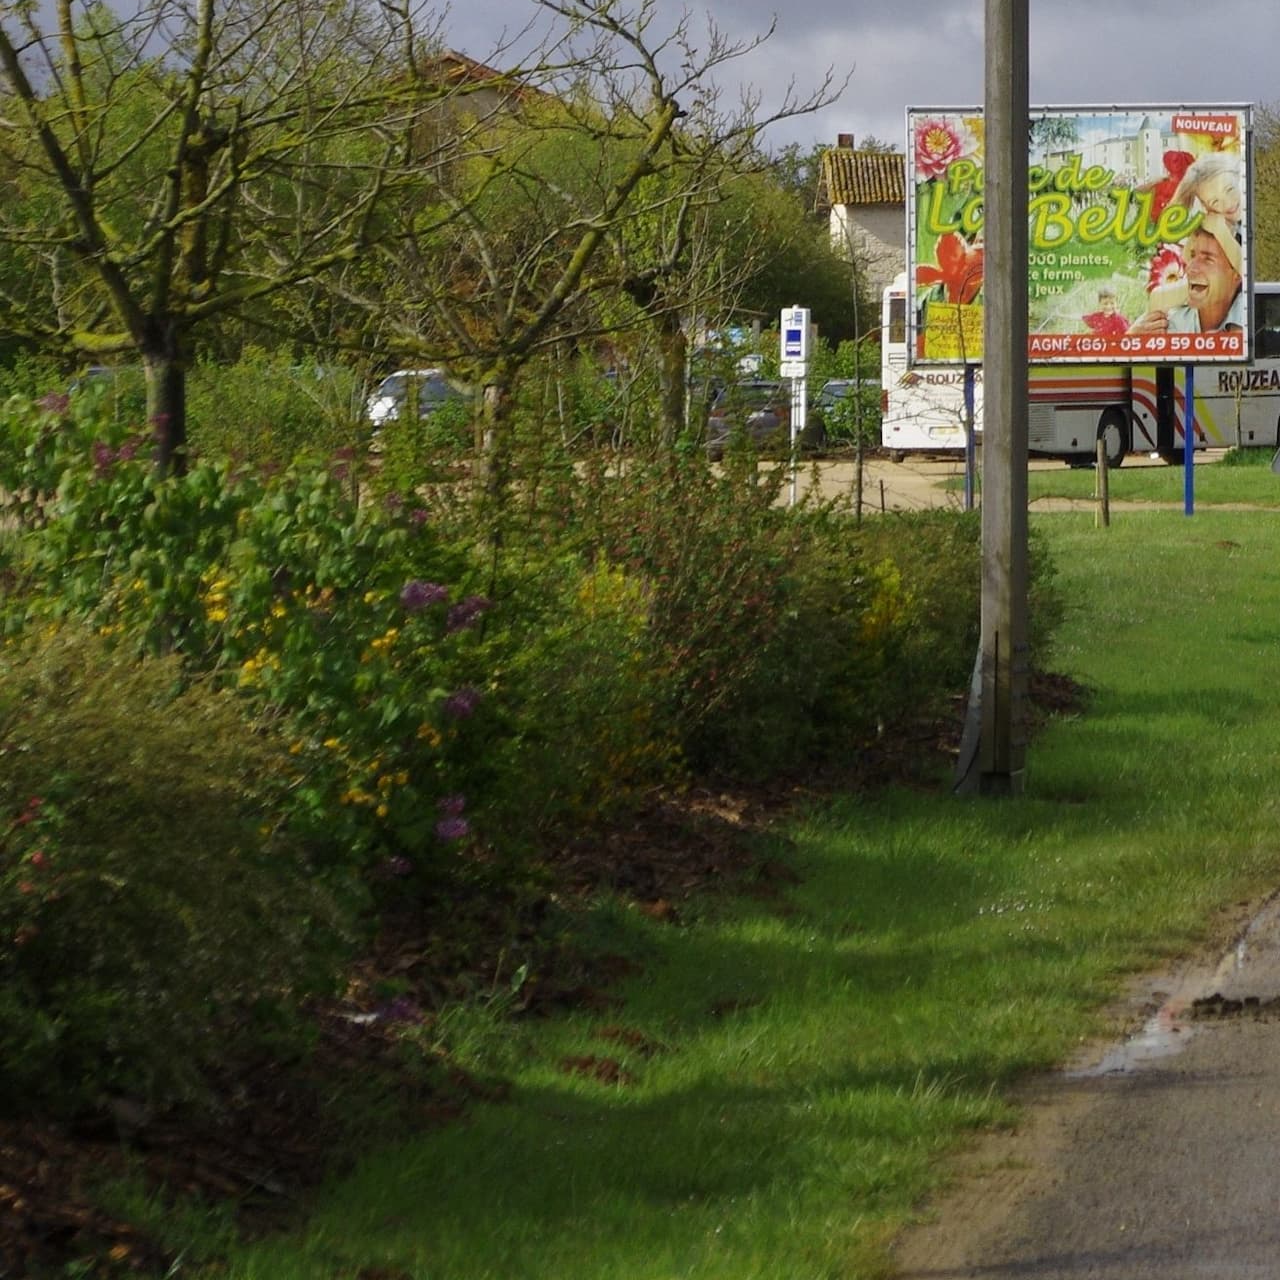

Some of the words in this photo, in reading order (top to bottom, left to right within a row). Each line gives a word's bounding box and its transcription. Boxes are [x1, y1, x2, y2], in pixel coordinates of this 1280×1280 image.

[1176, 118, 1232, 132] NOUVEAU
[1055, 154, 1114, 190] de
[1028, 186, 1204, 248] Belle
[1060, 253, 1113, 267] plantes,
[1043, 268, 1085, 281] ferme,
[1035, 282, 1064, 297] jeux
[1028, 335, 1072, 351] AGNÉ
[1076, 338, 1107, 352] (86)
[1120, 337, 1141, 351] 05
[1145, 337, 1166, 351] 49
[1170, 336, 1190, 350] 59
[1194, 336, 1216, 350] 06
[1220, 336, 1240, 350] 78
